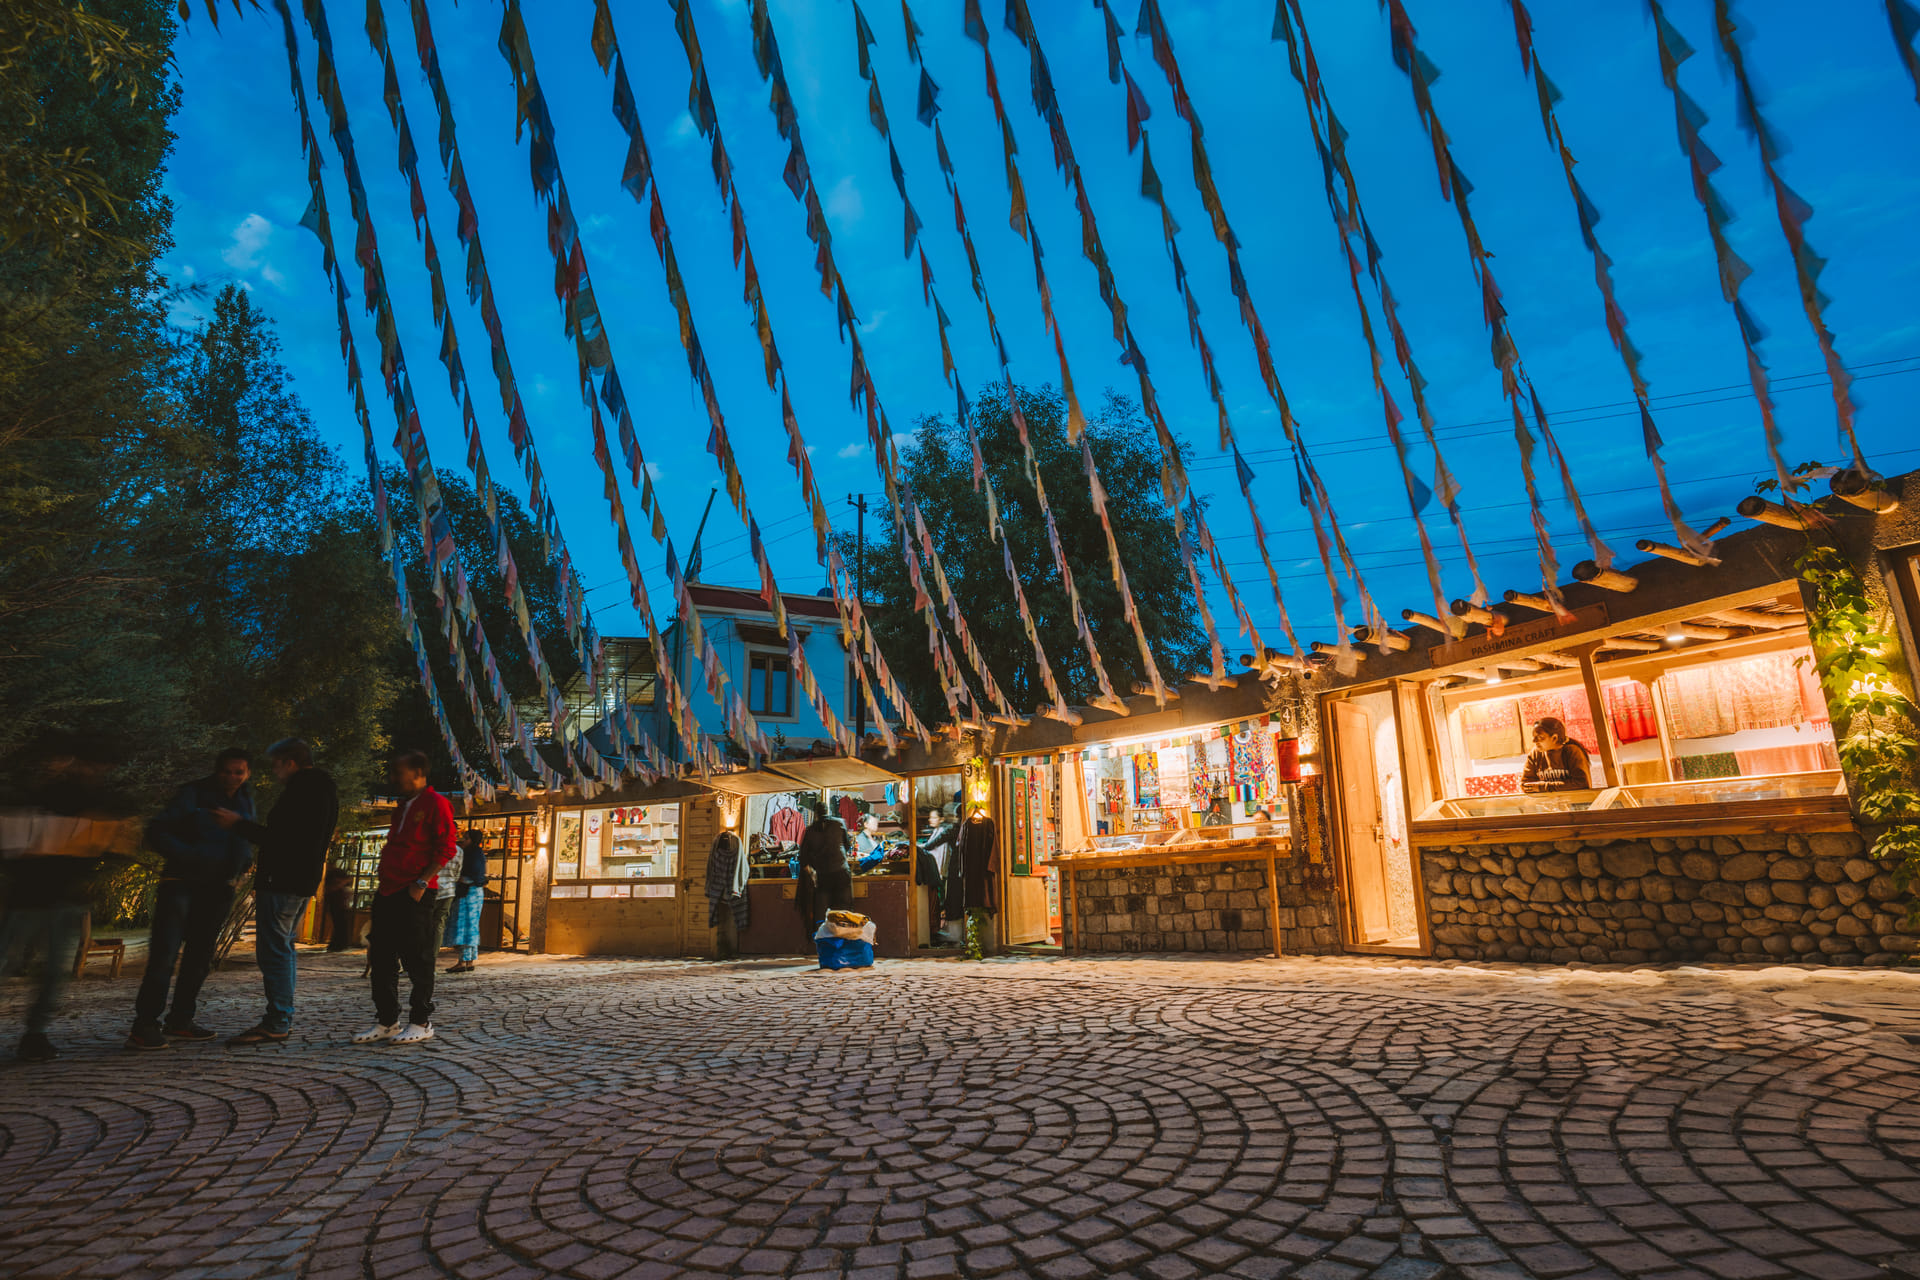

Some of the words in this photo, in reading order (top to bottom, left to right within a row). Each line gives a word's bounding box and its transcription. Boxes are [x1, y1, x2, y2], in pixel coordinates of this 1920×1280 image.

[1471, 637, 1522, 656] PASHMINA
[1525, 627, 1555, 641] CRAFT
[1282, 708, 1290, 722] 4
[965, 765, 971, 776] 5
[717, 795, 723, 805] 6
